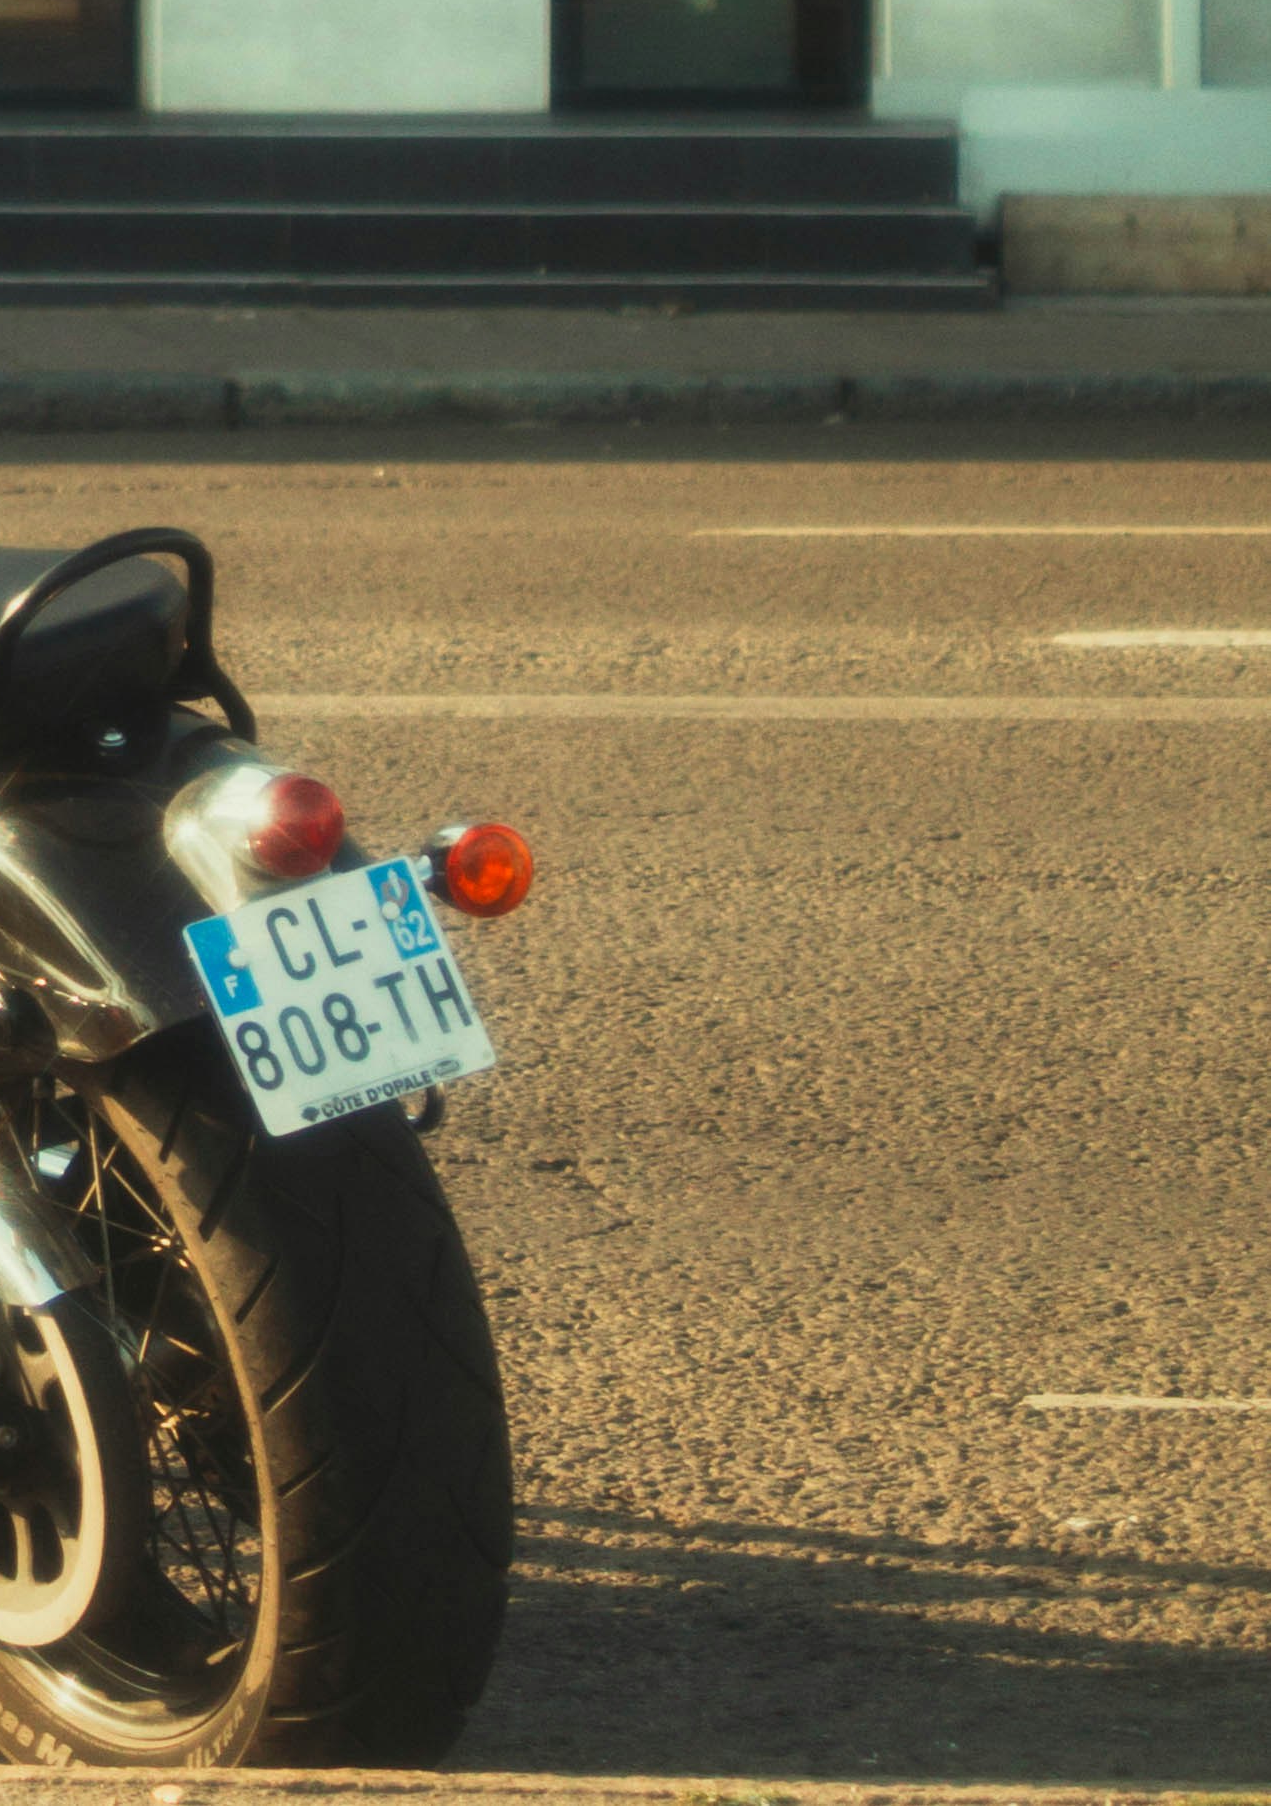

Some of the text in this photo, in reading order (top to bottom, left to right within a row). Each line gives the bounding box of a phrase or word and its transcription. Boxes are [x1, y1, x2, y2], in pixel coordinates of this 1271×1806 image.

[392, 910, 435, 953] 62
[223, 974, 241, 999] F
[235, 957, 473, 1092] 808-TH
[320, 1070, 434, 1119] CÔTE D'OPALE
